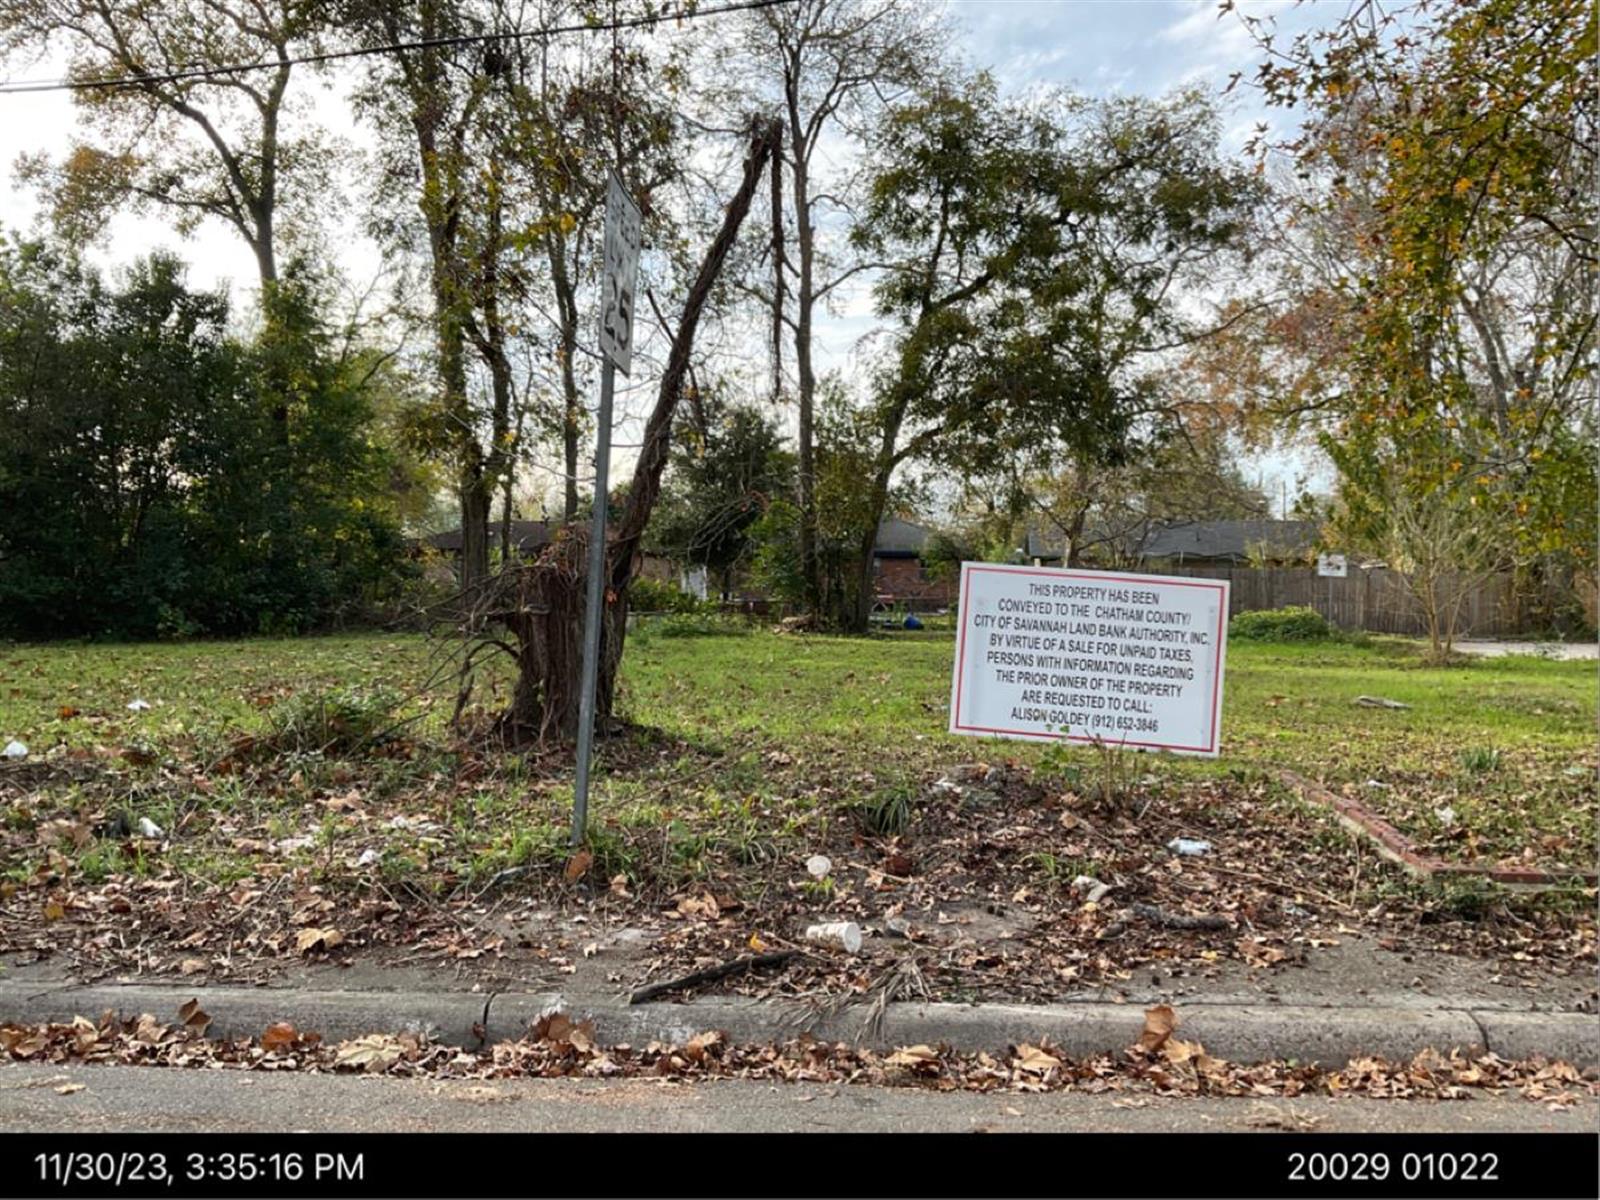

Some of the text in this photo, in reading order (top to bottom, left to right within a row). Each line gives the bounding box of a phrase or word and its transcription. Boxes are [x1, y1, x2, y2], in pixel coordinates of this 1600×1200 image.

[604, 272, 631, 350] 25
[1029, 583, 1159, 605] THIS PROPERTY HAS BEEN
[998, 598, 1191, 625] CONVEYED TO THE CHATHAM COUNTY/
[974, 614, 996, 628] CITY
[998, 616, 1012, 629] OF
[1014, 617, 1067, 633] SAVANNAH
[1069, 622, 1096, 635] LAND
[1099, 624, 1127, 638] BANK
[1190, 631, 1210, 645] INC.
[990, 633, 1004, 646] BY
[1005, 635, 1041, 650] VIRTUE
[1043, 638, 1058, 651] OF
[1059, 639, 1067, 652] A
[1068, 640, 1095, 654] SALE
[1097, 642, 1118, 656] FOR
[1120, 644, 1156, 659] UNPAID
[987, 651, 1194, 680] PERSONS WITH INFORMATION REGARDING
[996, 669, 1183, 697] THE PRIOR OWNER OF THE PROPERTY
[1021, 689, 1152, 713] ARE REQUESTED TO CALL:
[1011, 707, 1159, 732] ALISON GOLDEY (912) 652-3846
